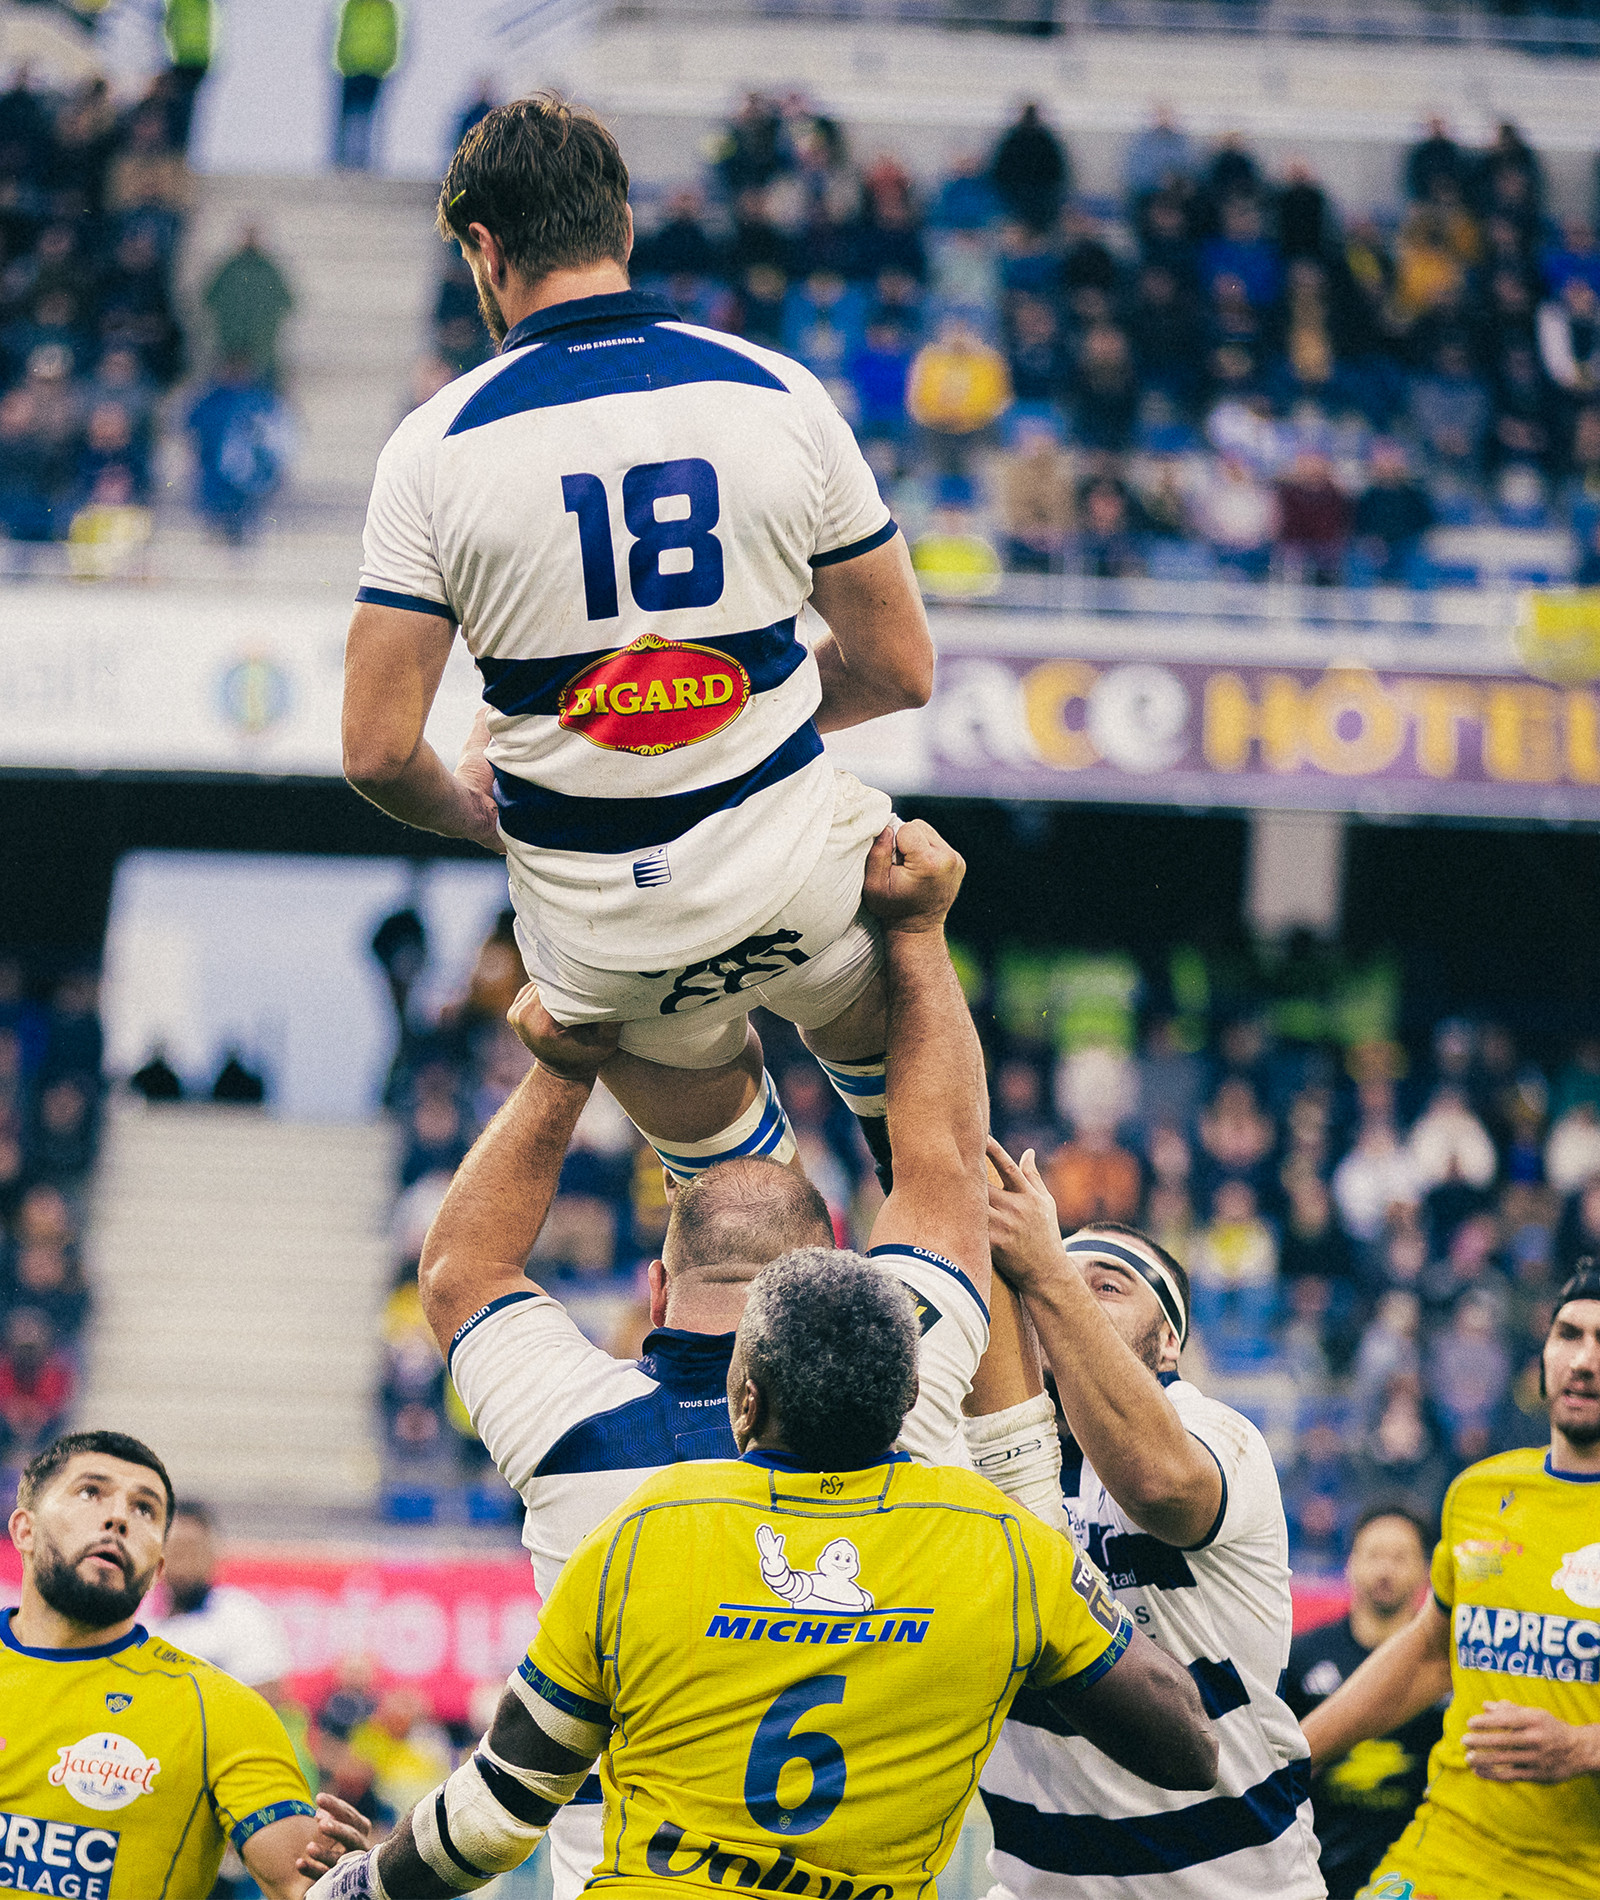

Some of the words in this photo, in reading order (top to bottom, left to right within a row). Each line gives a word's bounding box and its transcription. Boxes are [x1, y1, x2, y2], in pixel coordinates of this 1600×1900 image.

[567, 343, 592, 354] TOUS
[593, 336, 646, 349] ENSEMBLE
[560, 457, 724, 621] 18
[568, 673, 734, 717] BIGARD
[912, 1246, 960, 1273] umbro
[454, 1305, 491, 1341] umbro
[678, 1400, 703, 1409] TOUS
[704, 1396, 730, 1407] ENSE
[705, 1615, 930, 1645] MICHELIN
[1454, 1602, 1600, 1661] PAPREC
[52, 1750, 156, 1793] Jacquet
[744, 1674, 847, 1836] 6
[0, 1814, 119, 1874] REC
